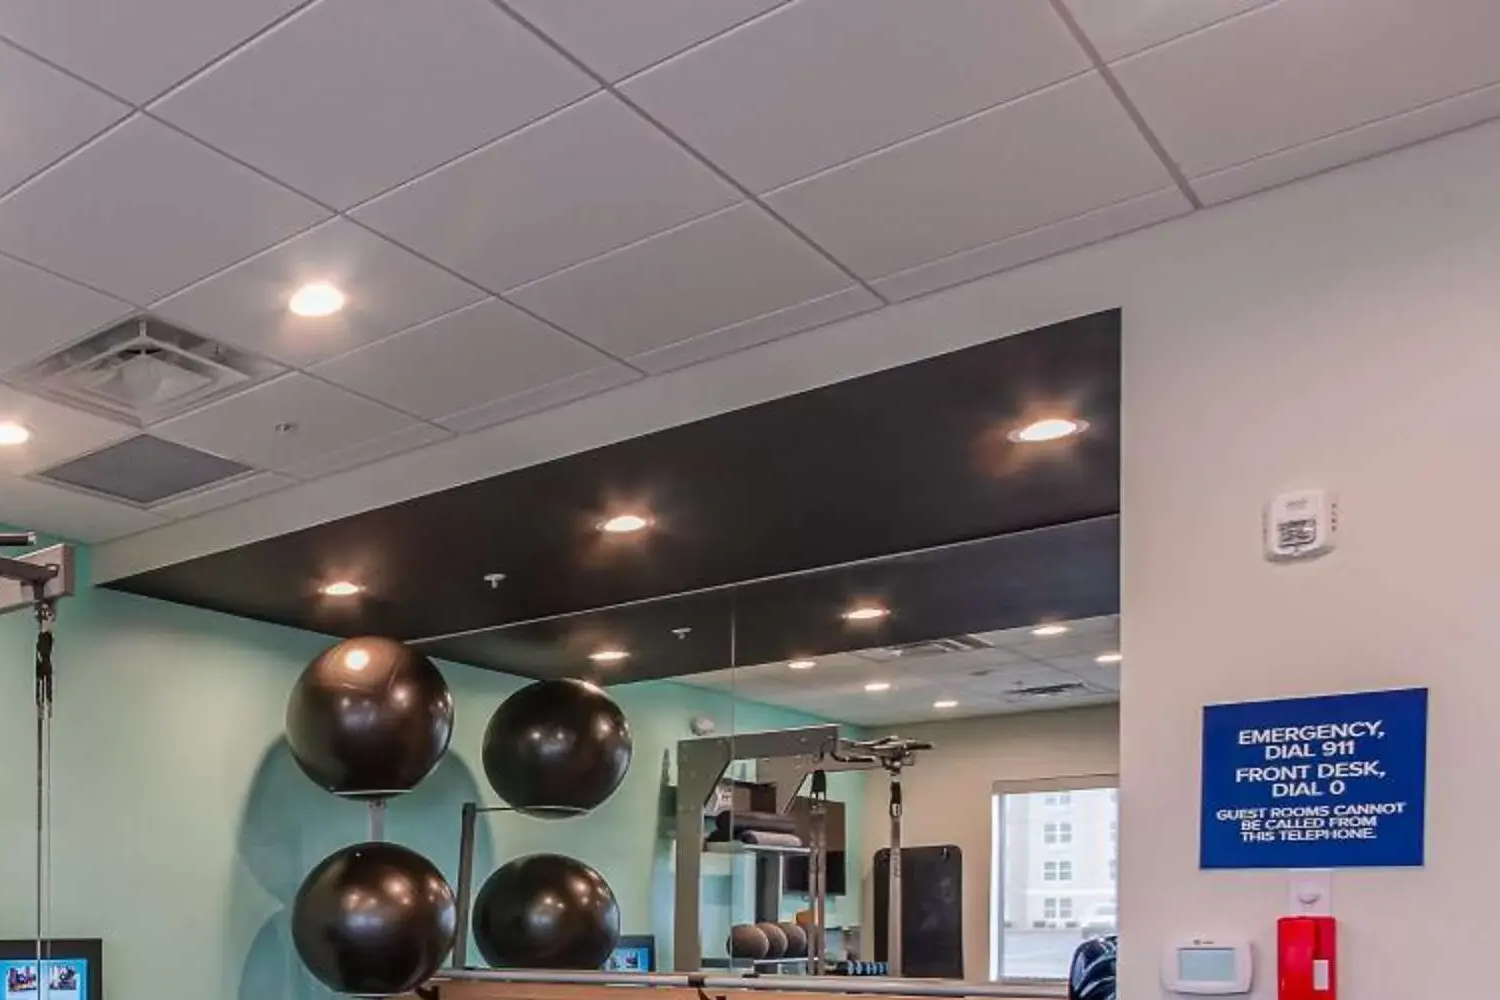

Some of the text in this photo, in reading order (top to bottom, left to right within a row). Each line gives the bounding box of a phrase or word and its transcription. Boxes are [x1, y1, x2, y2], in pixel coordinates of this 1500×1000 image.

[1238, 720, 1385, 746] EMERGENCY,
[1265, 740, 1355, 760] DIAL 911
[1235, 760, 1386, 783] FRONT DESK,
[1272, 781, 1324, 797] DIAL
[1216, 802, 1407, 821] GUEST ROOMS CANNOT
[1241, 816, 1377, 831] BE CALLED FROM
[1241, 831, 1275, 842] THIS
